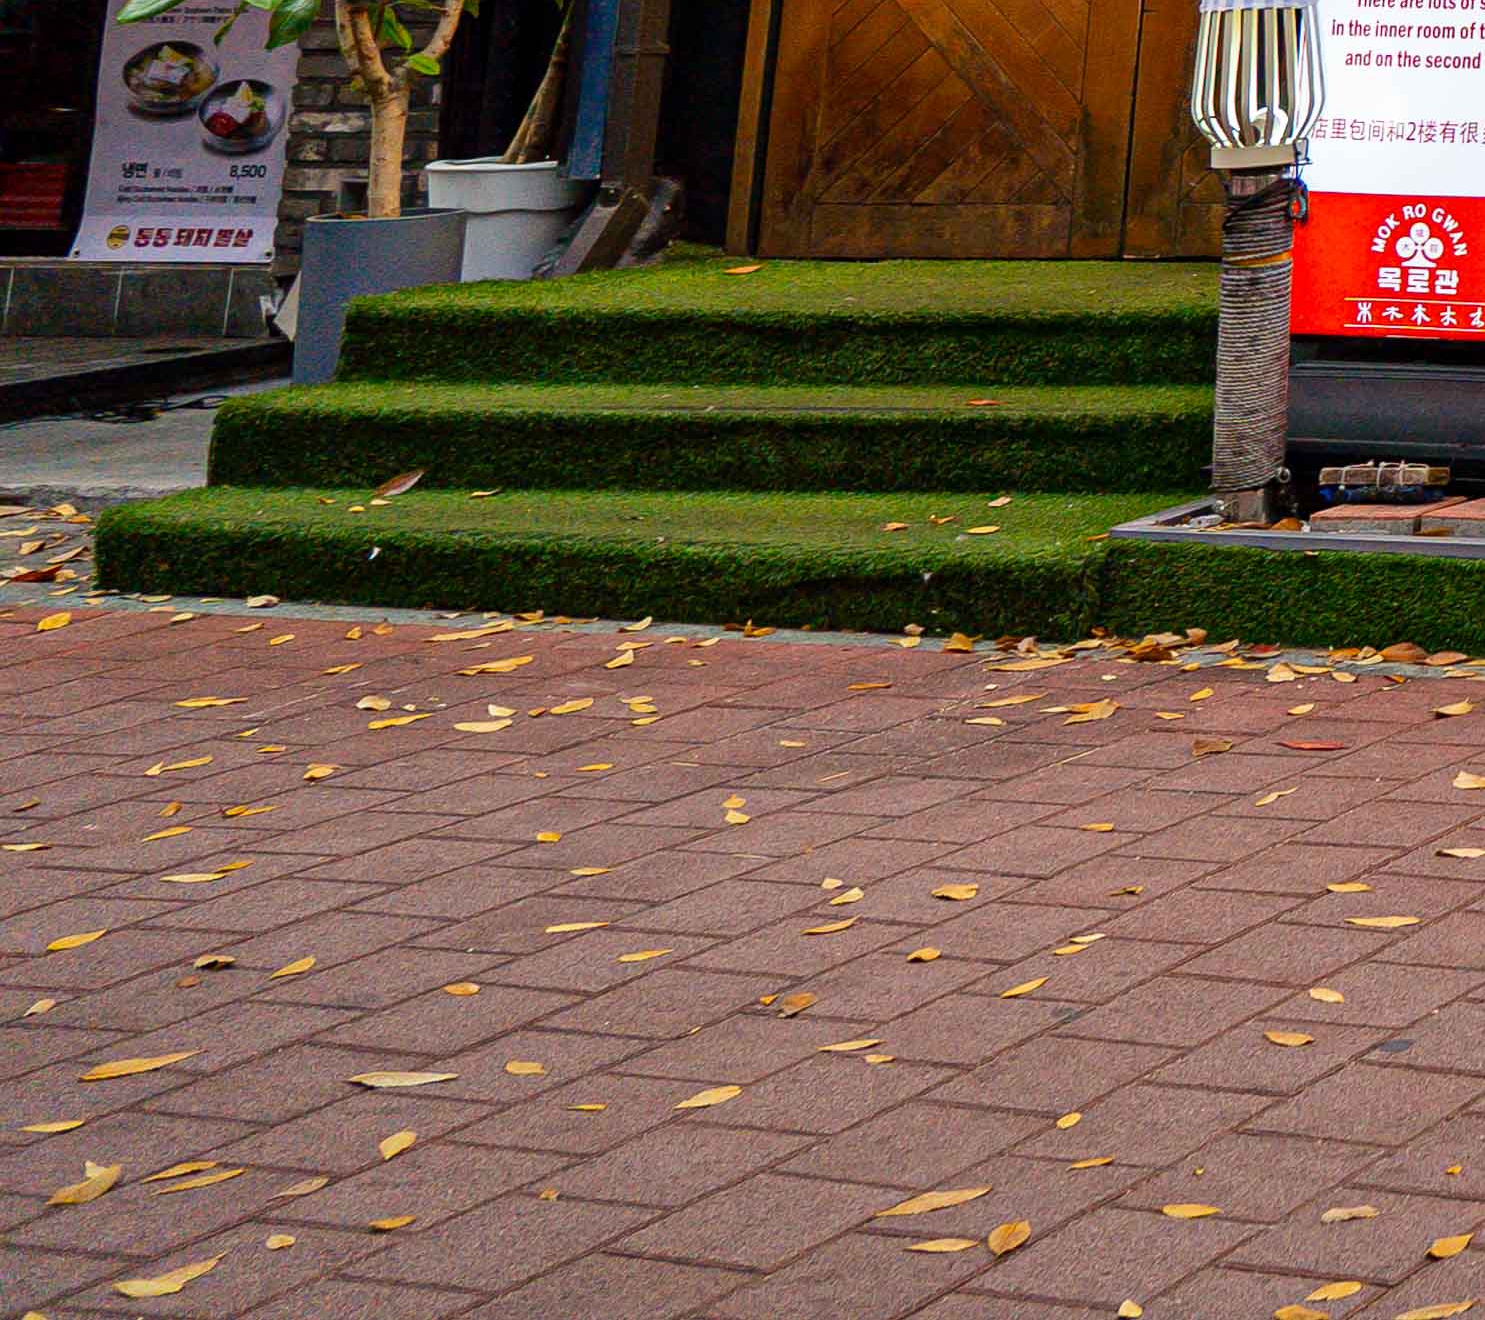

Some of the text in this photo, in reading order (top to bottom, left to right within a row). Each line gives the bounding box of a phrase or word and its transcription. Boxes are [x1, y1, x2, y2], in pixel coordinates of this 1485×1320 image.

[1332, 19, 1345, 37] in
[1348, 19, 1372, 38] the
[1375, 20, 1413, 39] inner
[1417, 24, 1455, 40] room
[1459, 22, 1476, 40] of
[1345, 50, 1372, 67] and
[1375, 53, 1393, 67] on
[1396, 51, 1421, 68] the
[1425, 51, 1481, 70] second
[229, 164, 267, 179] 8,500
[1377, 266, 1460, 296] 목로관
